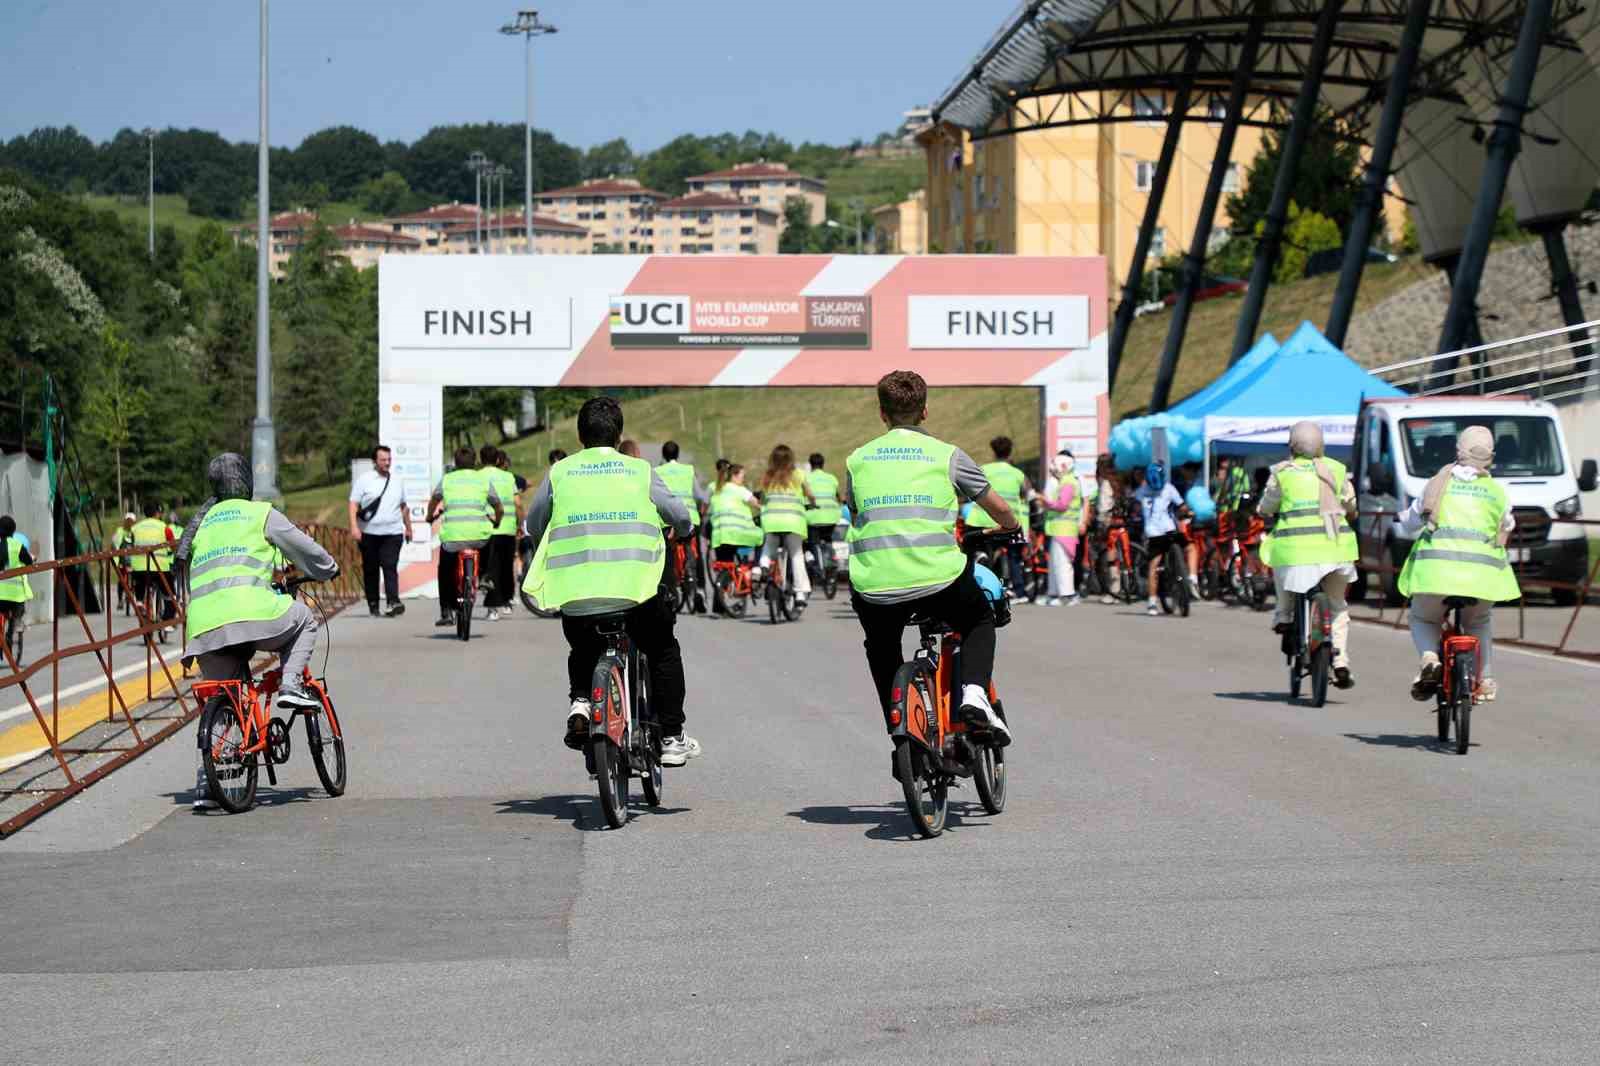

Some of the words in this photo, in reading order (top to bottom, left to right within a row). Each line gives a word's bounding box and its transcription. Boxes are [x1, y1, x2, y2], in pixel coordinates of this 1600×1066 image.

[695, 302, 721, 313] MTB
[724, 302, 800, 313] ELIMINATOR
[811, 302, 865, 314] SAKARYA
[624, 303, 683, 325] UCI
[424, 310, 532, 335] FINISH
[695, 315, 741, 327] WORLD
[744, 315, 769, 327] CUP
[947, 311, 1054, 335] FINISH
[581, 461, 624, 469] SAKARYA
